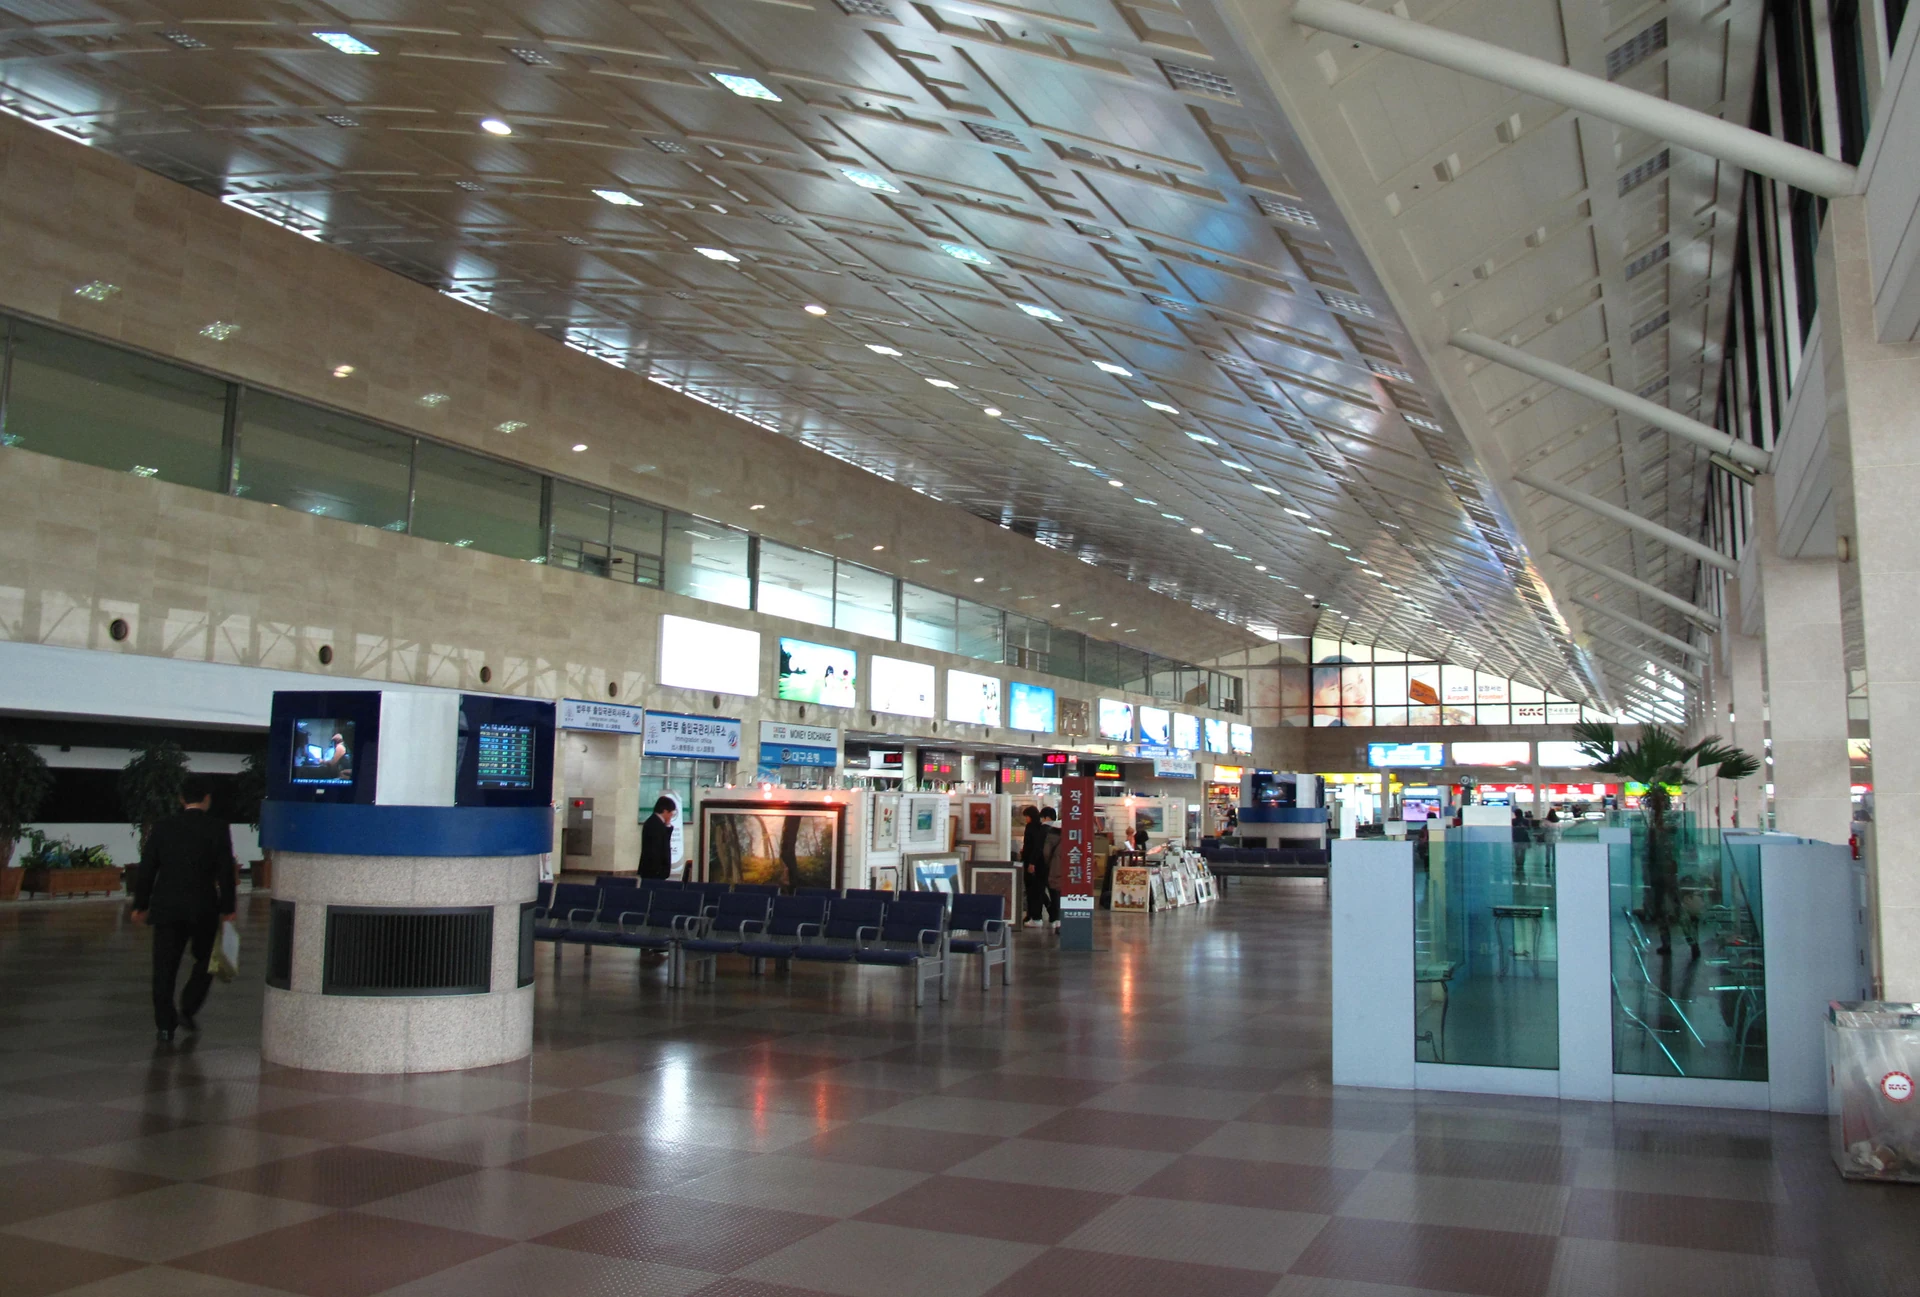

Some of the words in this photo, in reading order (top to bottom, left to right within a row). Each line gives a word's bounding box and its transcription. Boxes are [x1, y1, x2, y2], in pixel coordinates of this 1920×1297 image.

[576, 705, 591, 714] 법무부
[593, 706, 632, 718] 출입국관리사무소
[1519, 708, 1544, 716] KAC
[661, 721, 679, 733] 법무부
[681, 722, 727, 737] 출입국관리사무소
[790, 729, 807, 740] MONEY
[807, 730, 832, 742] EXCHANGE
[792, 751, 820, 763] 대구은행
[1070, 790, 1082, 820] 작은
[1067, 829, 1083, 884] 미술관
[1067, 893, 1088, 902] KAC
